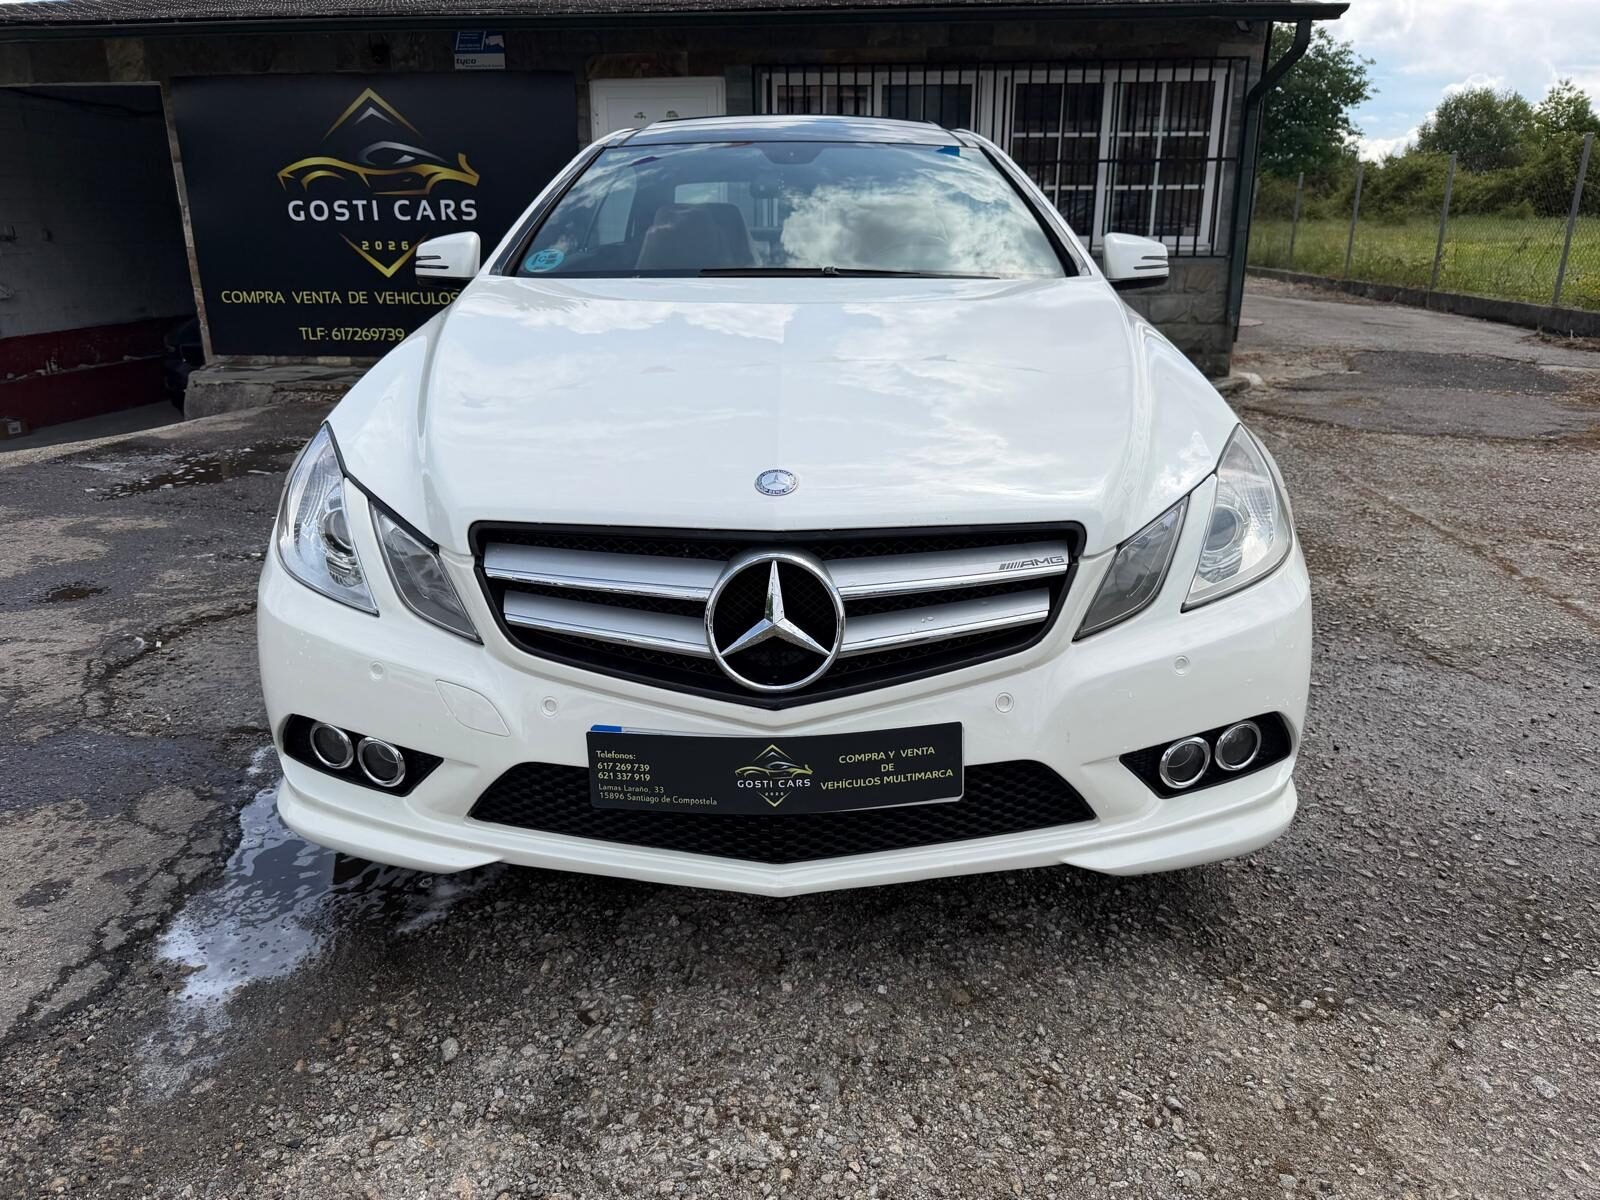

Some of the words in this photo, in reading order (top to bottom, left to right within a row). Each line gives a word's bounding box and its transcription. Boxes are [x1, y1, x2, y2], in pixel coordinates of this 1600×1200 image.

[288, 200, 379, 221] GOSTI
[394, 199, 478, 221] CARS
[362, 240, 410, 250] 2026
[221, 290, 286, 304] COMPRA
[292, 291, 342, 304] VENTA
[349, 291, 368, 304] DE
[299, 327, 329, 341] TLF:
[331, 327, 405, 342] 617269739
[1020, 555, 1065, 568] AMG
[596, 750, 636, 760] Telefonos:
[838, 751, 886, 764] COMPRA
[888, 750, 895, 760] Y
[900, 746, 935, 758] VENTA
[597, 762, 613, 770] 617
[615, 762, 632, 771] 269
[633, 763, 650, 772] 739
[881, 763, 894, 772] DE
[598, 771, 614, 780] 621
[616, 773, 632, 781] 337
[633, 774, 650, 782] 919
[820, 775, 881, 790] VEHÍCULOS
[883, 769, 953, 785] MULTIMARCA
[598, 784, 622, 792] Lamas
[737, 780, 773, 789] GOSTI
[778, 779, 811, 788] CARS
[600, 792, 625, 800] 15896
[627, 793, 659, 804] Santiago
[661, 795, 671, 803] de
[673, 795, 718, 806] Compostela
